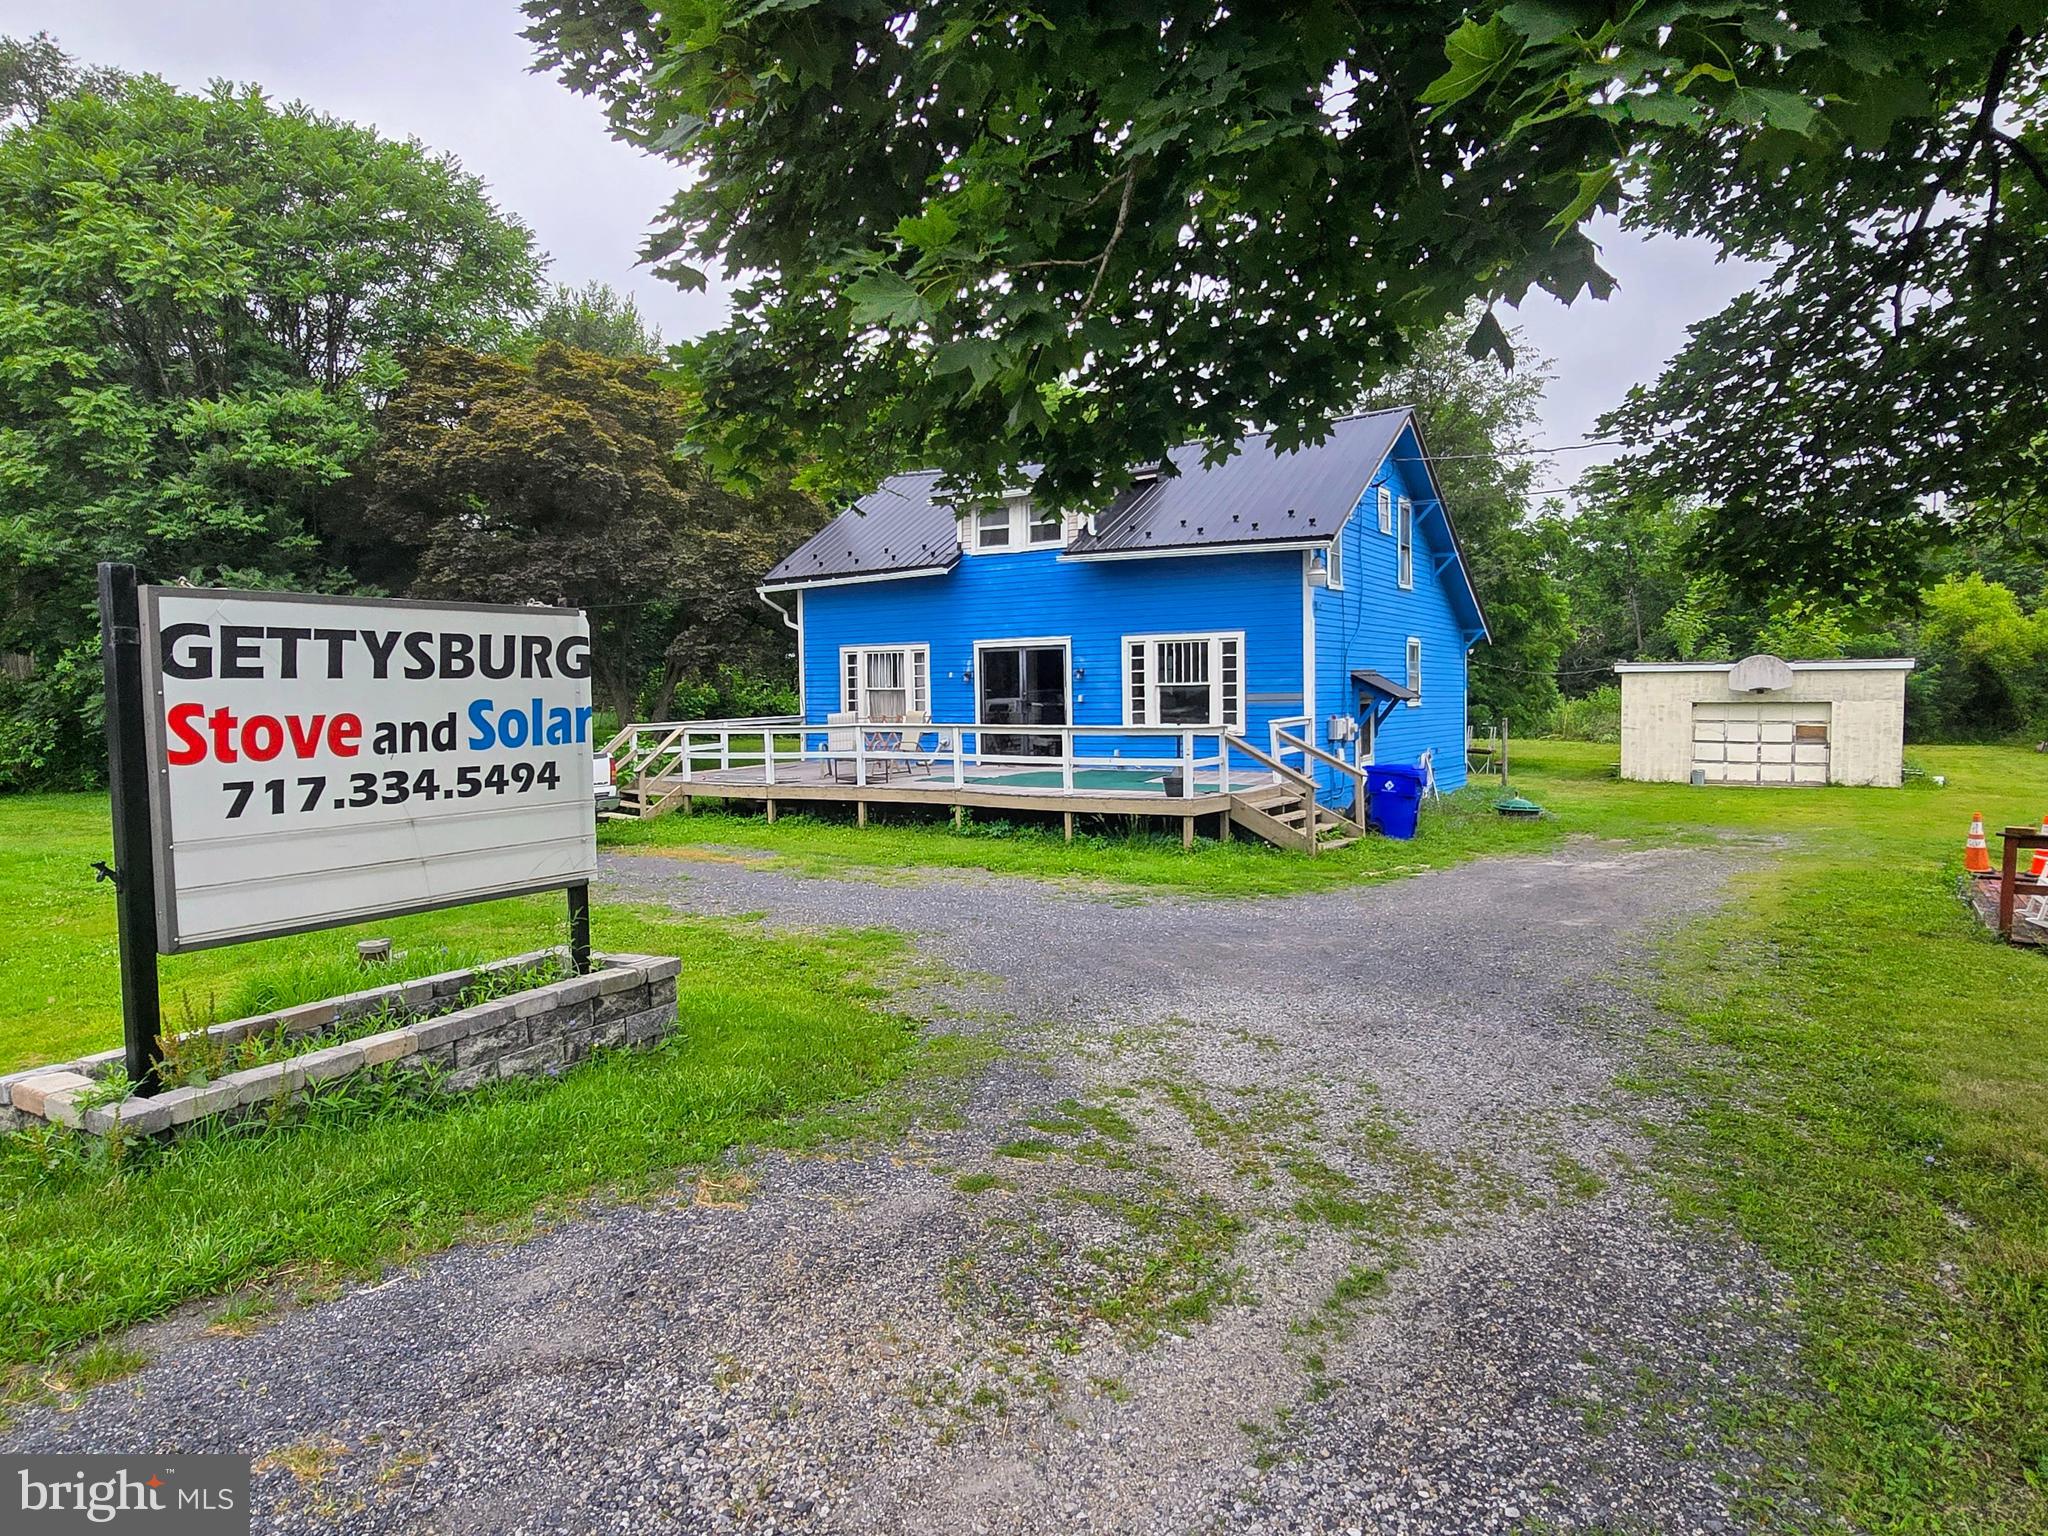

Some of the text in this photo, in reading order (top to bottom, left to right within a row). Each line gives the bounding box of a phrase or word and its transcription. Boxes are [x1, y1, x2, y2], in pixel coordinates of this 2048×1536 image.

[160, 622, 592, 680] GETTYSBURG
[167, 698, 593, 766] Stove and Solar
[222, 761, 561, 819] 717.334.5494
